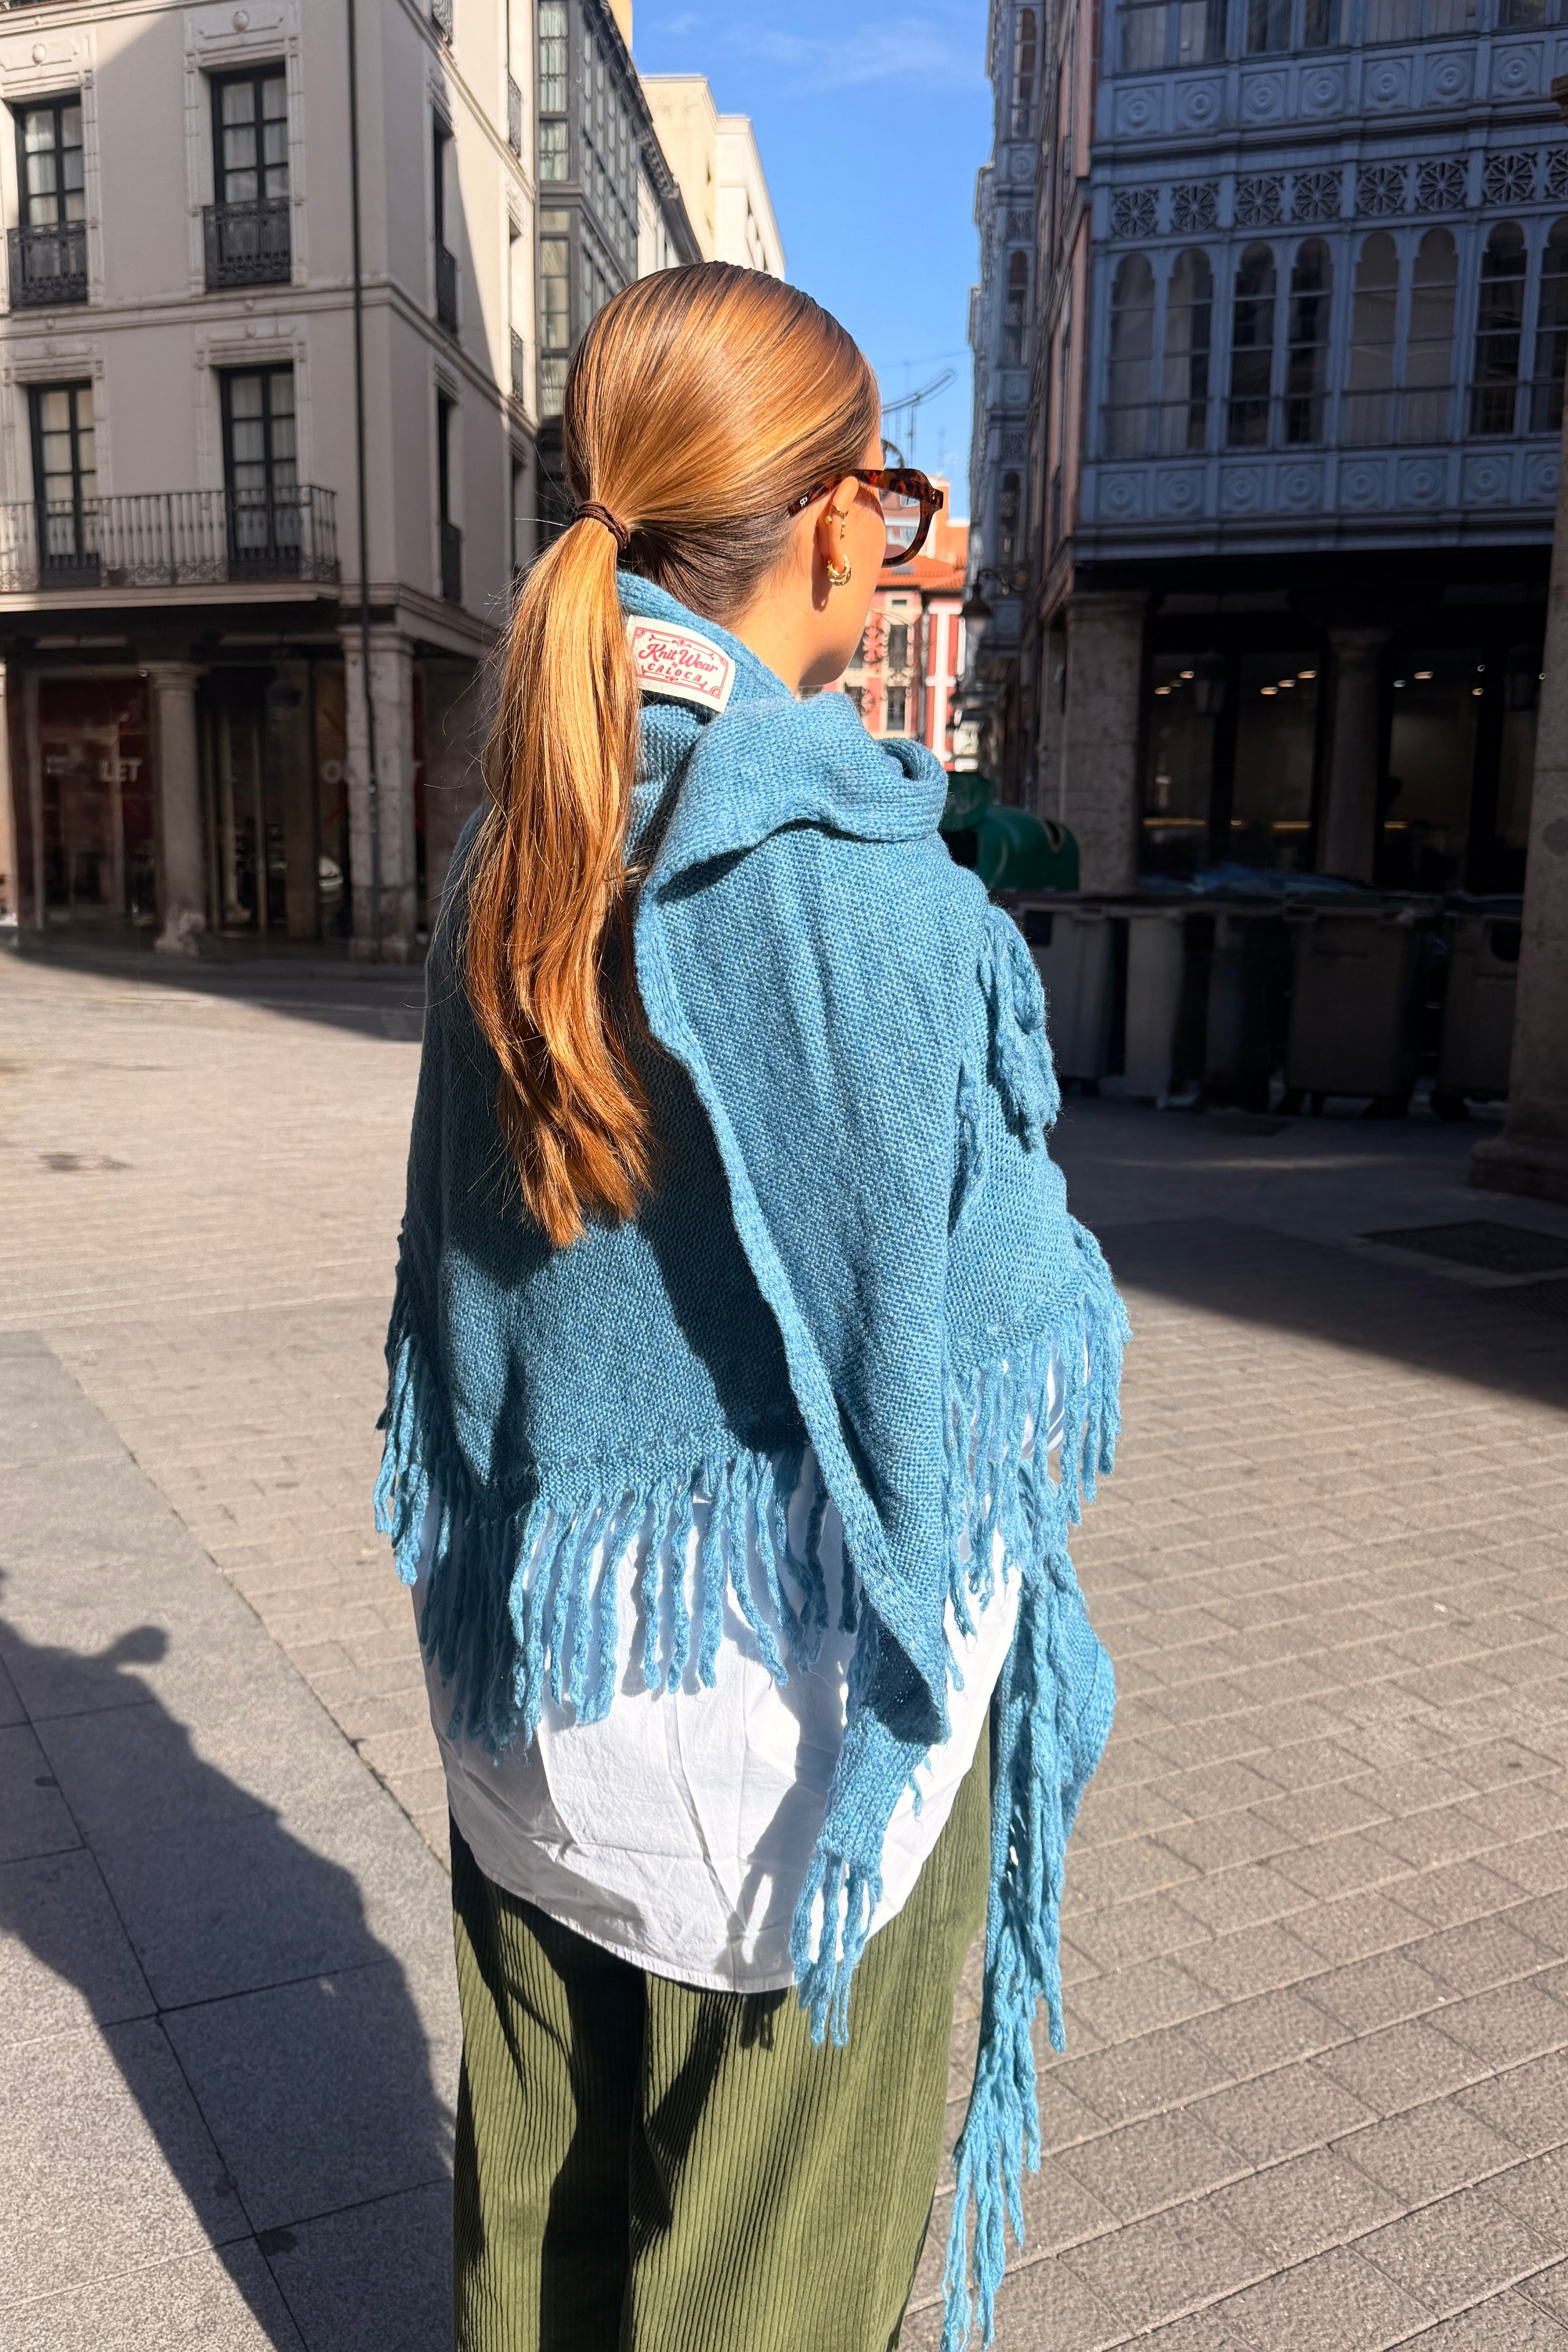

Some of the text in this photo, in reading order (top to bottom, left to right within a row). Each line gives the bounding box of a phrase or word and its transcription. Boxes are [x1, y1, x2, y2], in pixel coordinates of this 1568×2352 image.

[638, 643, 718, 672] Knit Wear
[648, 663, 702, 681] CALOCA
